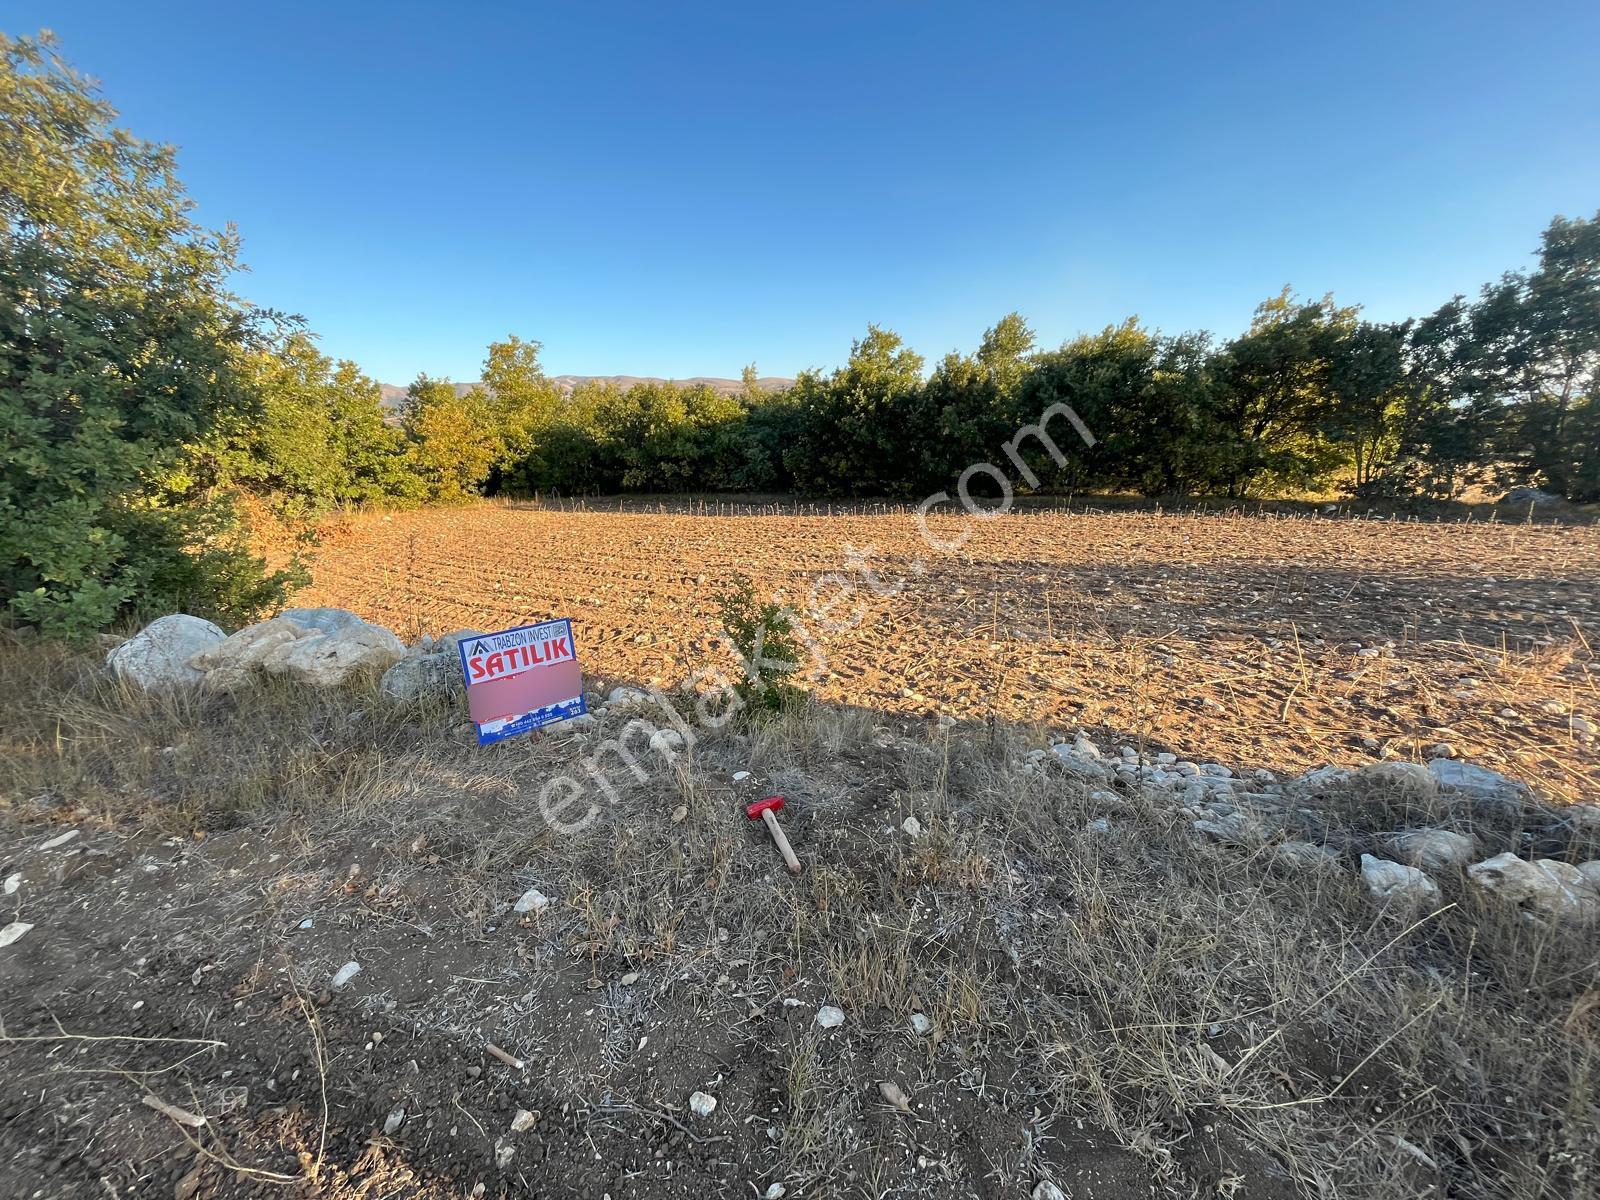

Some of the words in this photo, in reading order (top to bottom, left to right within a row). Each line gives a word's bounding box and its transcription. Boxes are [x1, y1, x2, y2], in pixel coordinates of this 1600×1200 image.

[492, 632, 527, 649] TRABZON
[527, 625, 553, 642] INVEST
[469, 636, 570, 679] SATILIK
